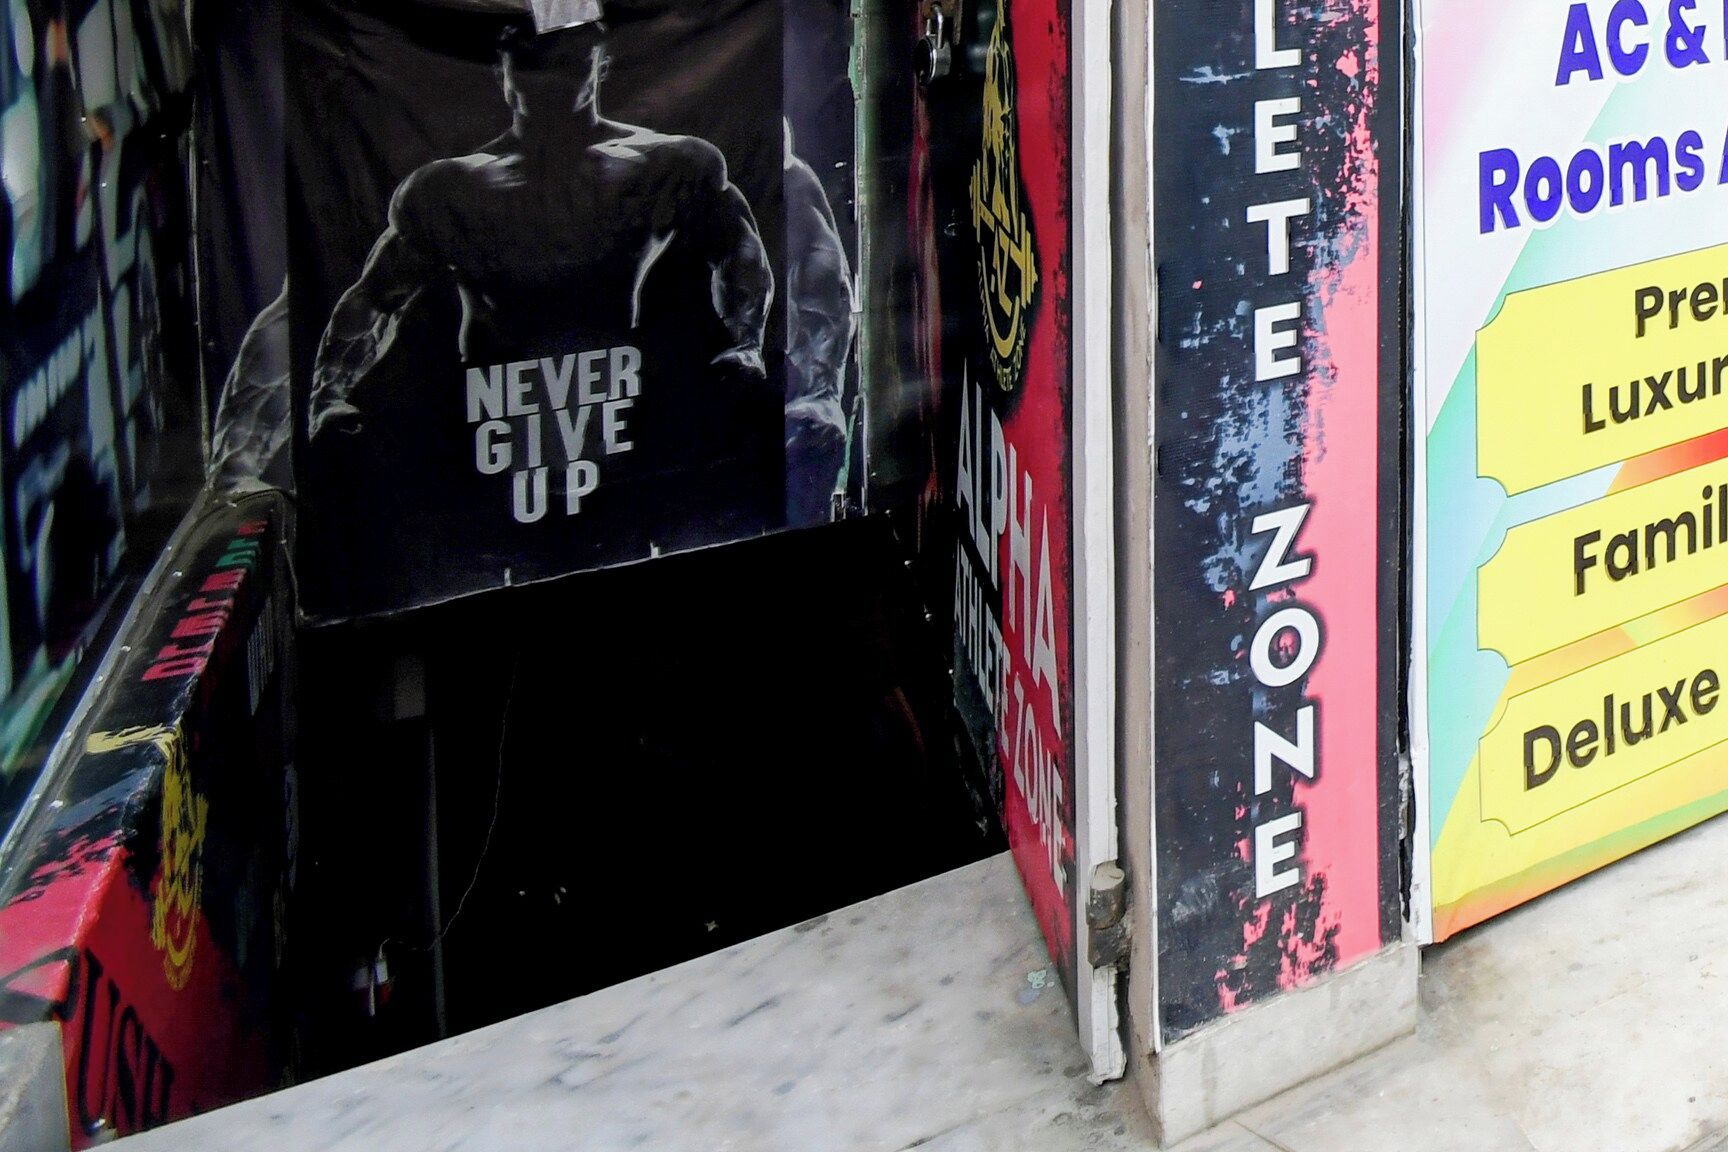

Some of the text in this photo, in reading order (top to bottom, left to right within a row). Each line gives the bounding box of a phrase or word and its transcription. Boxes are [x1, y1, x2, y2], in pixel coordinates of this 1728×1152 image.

[1479, 128, 1705, 235] Rooms
[465, 345, 642, 424] NEVER
[475, 398, 635, 475] GIVE
[512, 459, 600, 524] UP
[957, 357, 1062, 741] ALPHA
[954, 537, 1068, 898] ATHLETE ZONE
[1249, 502, 1320, 900] ZONE
[1521, 665, 1721, 792] Deluxe
